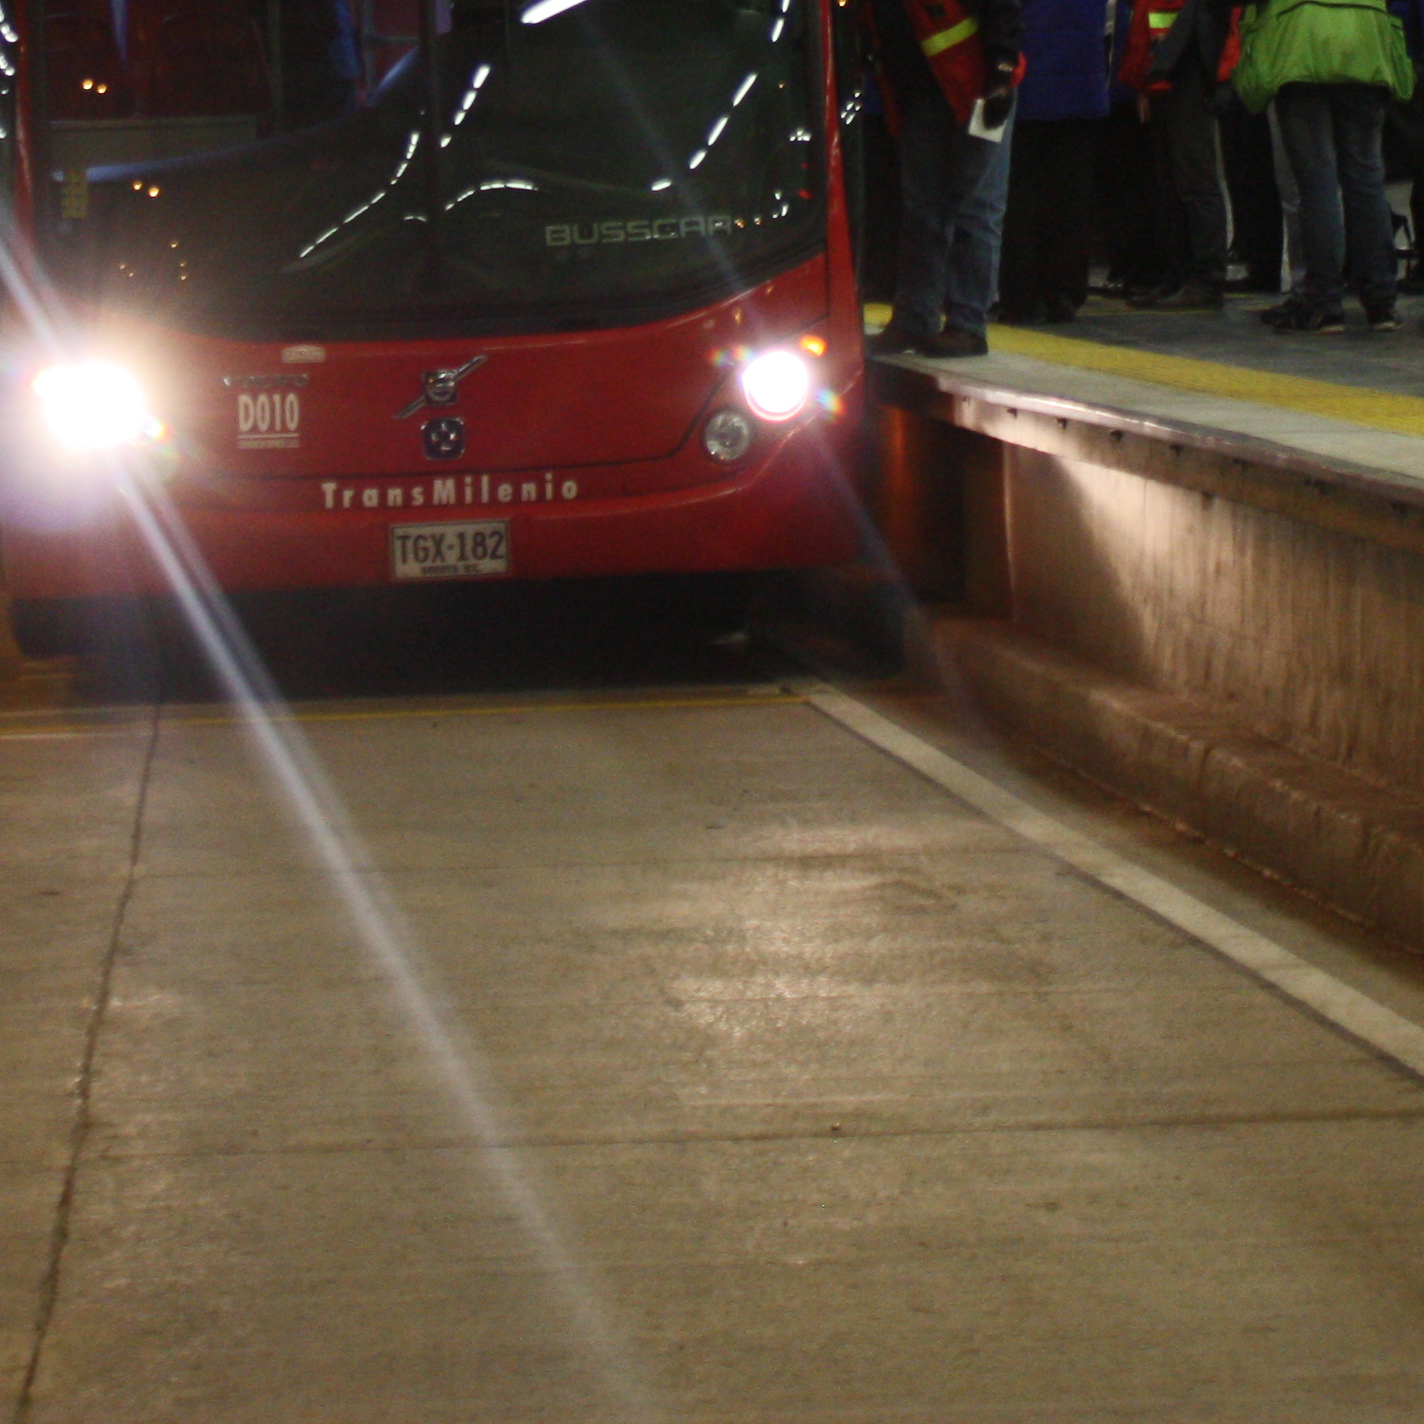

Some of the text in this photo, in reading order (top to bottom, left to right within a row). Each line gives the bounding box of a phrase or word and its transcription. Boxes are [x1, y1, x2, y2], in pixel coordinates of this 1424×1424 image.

[545, 215, 731, 248] BUSSCAR
[238, 393, 300, 433] D010
[321, 473, 578, 509] TransMilenio
[396, 530, 505, 564] TGX-182
